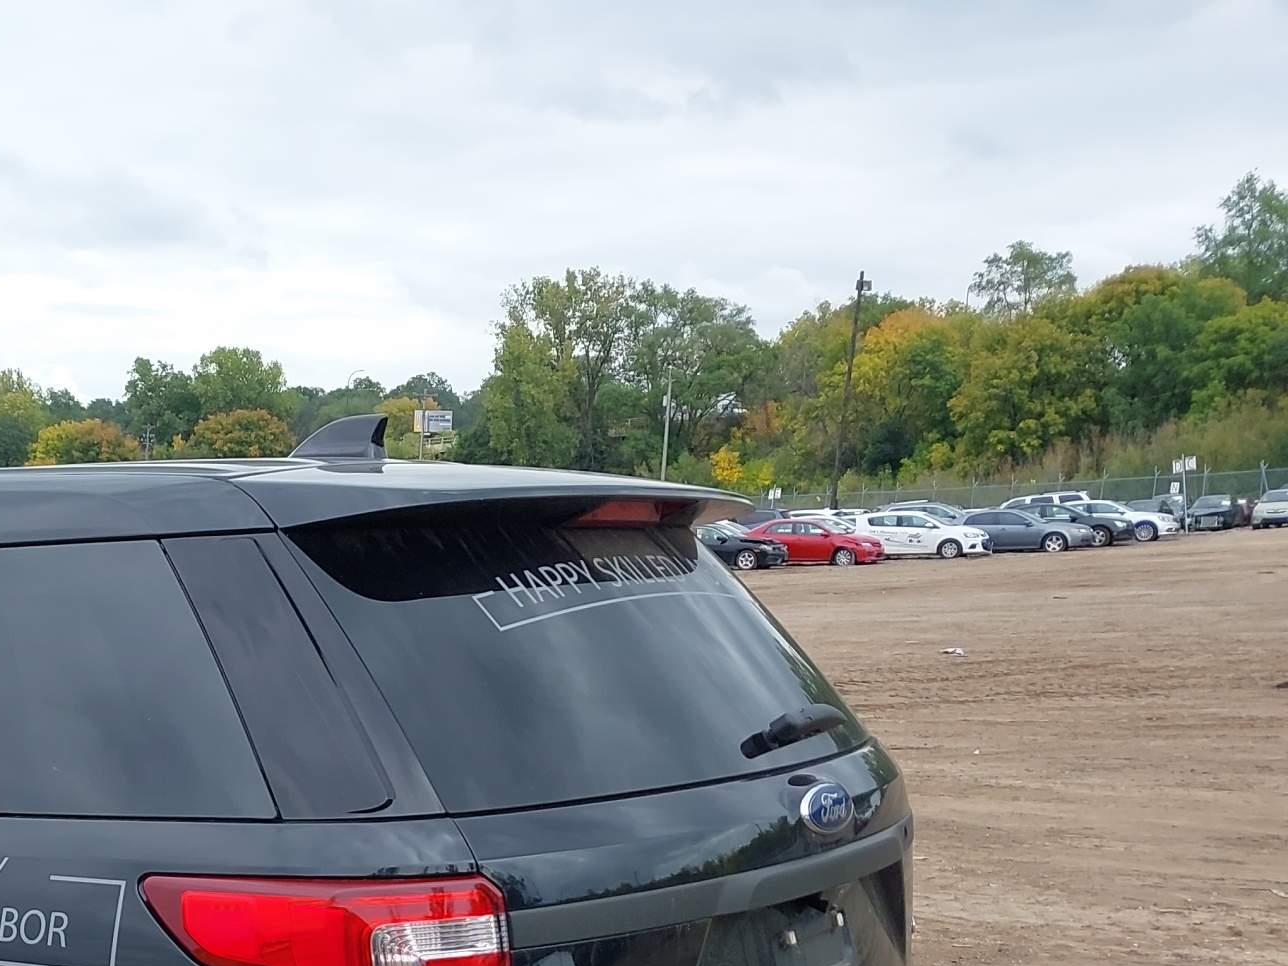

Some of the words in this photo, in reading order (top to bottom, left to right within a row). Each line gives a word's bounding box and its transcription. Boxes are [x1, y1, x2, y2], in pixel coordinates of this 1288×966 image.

[496, 559, 601, 607] HAPPY
[593, 555, 684, 587] SKILLED
[821, 792, 848, 823] Ford
